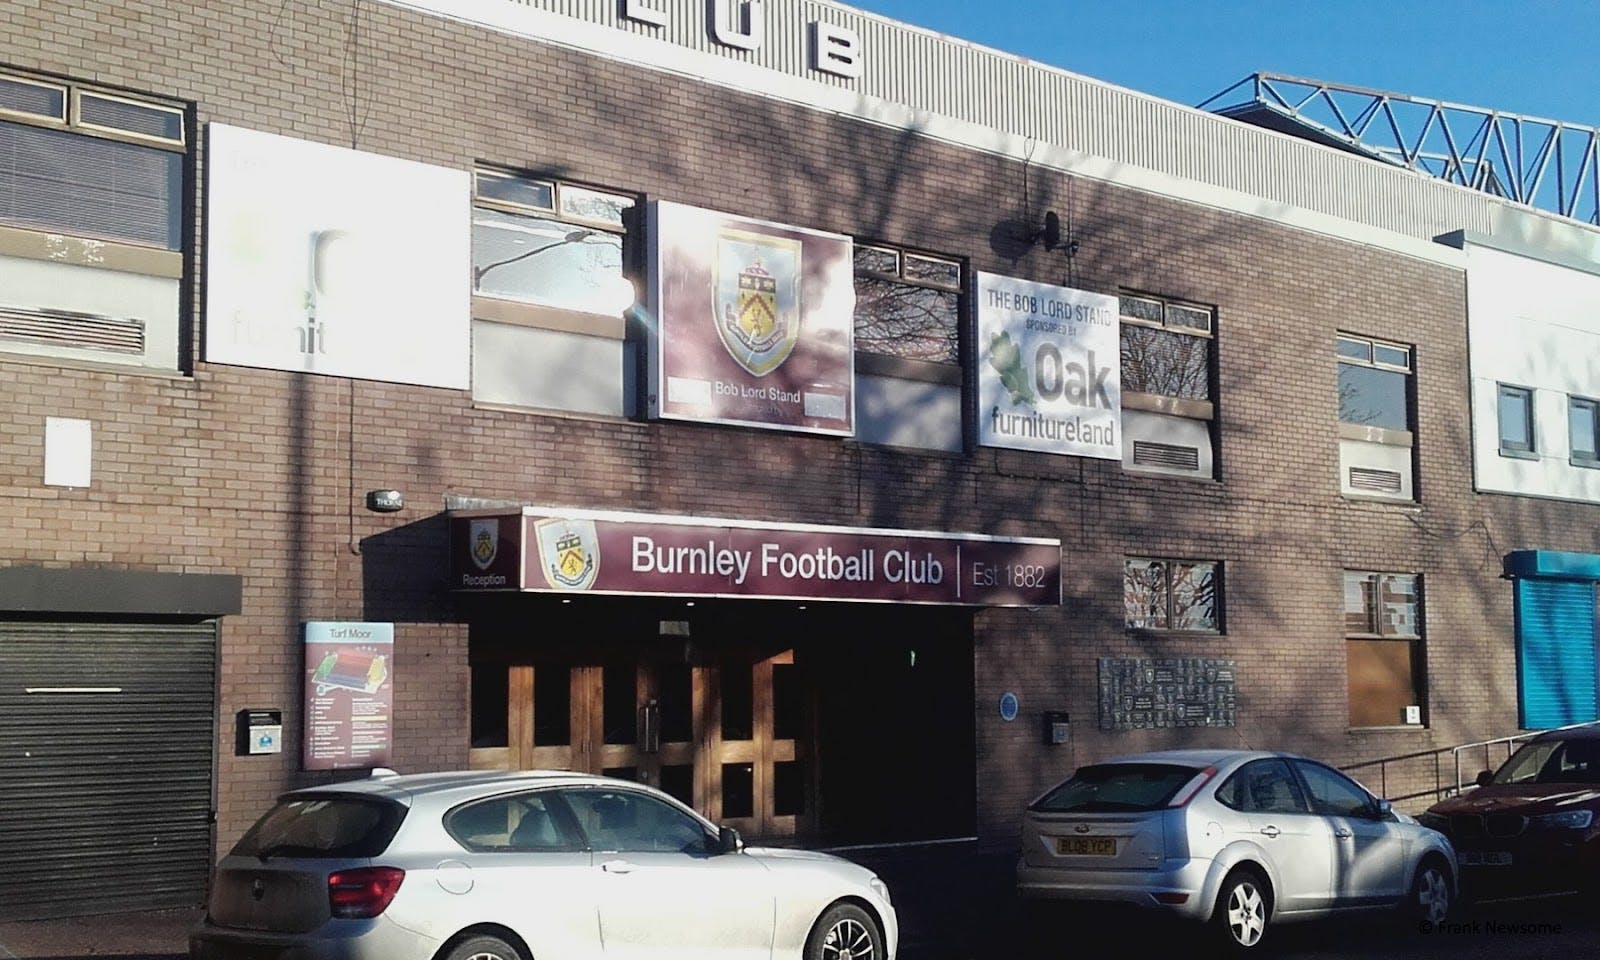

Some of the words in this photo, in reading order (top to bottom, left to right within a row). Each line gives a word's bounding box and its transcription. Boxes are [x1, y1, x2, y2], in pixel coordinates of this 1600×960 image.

[987, 288, 1011, 310] THE
[1014, 294, 1038, 314] BOB
[1041, 298, 1072, 320] LORD
[715, 380, 739, 396] Bob
[741, 383, 766, 399] Lord
[769, 387, 801, 403] Stand
[1035, 342, 1113, 410] Oak
[992, 406, 1114, 446] furnitureland
[632, 535, 751, 585] Burnley
[761, 543, 874, 582] Football
[883, 550, 943, 585] Club
[972, 562, 999, 587] Est
[1004, 564, 1046, 589] 1882
[463, 573, 506, 586] Reception
[330, 628, 348, 639] Turf
[349, 629, 372, 639] Moor
